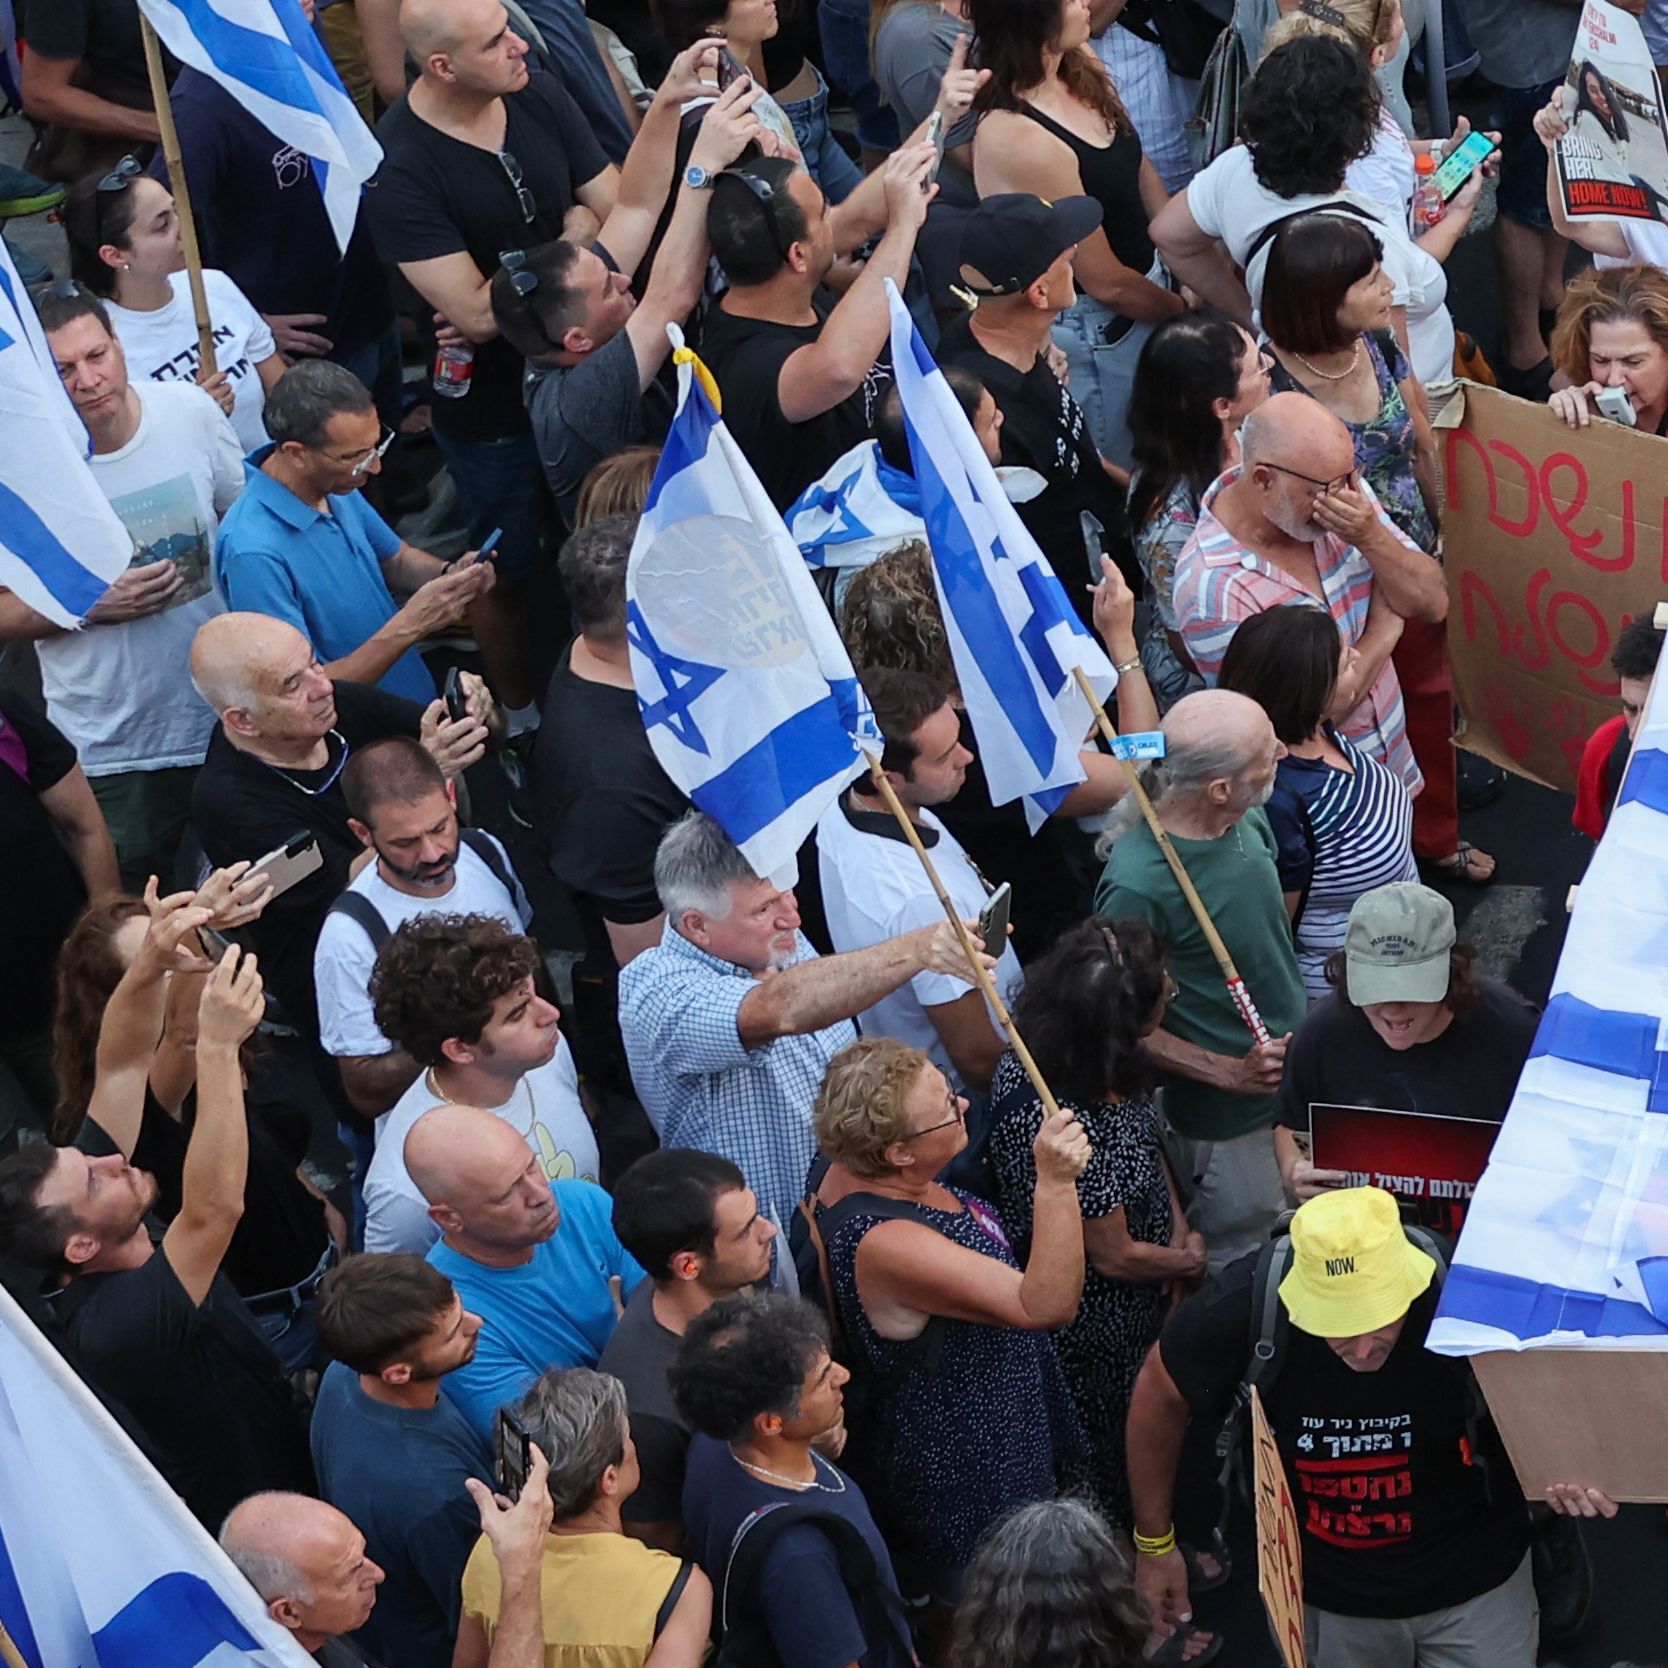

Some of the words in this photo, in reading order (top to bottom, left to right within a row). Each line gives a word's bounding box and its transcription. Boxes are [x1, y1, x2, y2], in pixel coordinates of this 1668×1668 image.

[1561, 136, 1603, 160] BRING
[1564, 157, 1595, 180] HER
[1567, 181, 1609, 205] HOME
[1375, 1172, 1425, 1195] להציל
[1325, 1256, 1359, 1277] NOW.
[1302, 1416, 1324, 1428] עוז
[1330, 1418, 1352, 1429] ניר
[1358, 1413, 1412, 1430] בקיבוץ
[1297, 1433, 1314, 1452] 4
[1323, 1433, 1393, 1457] מתוך
[1299, 1470, 1412, 1501] נחטפו
[1307, 1499, 1411, 1536] נרצחו
